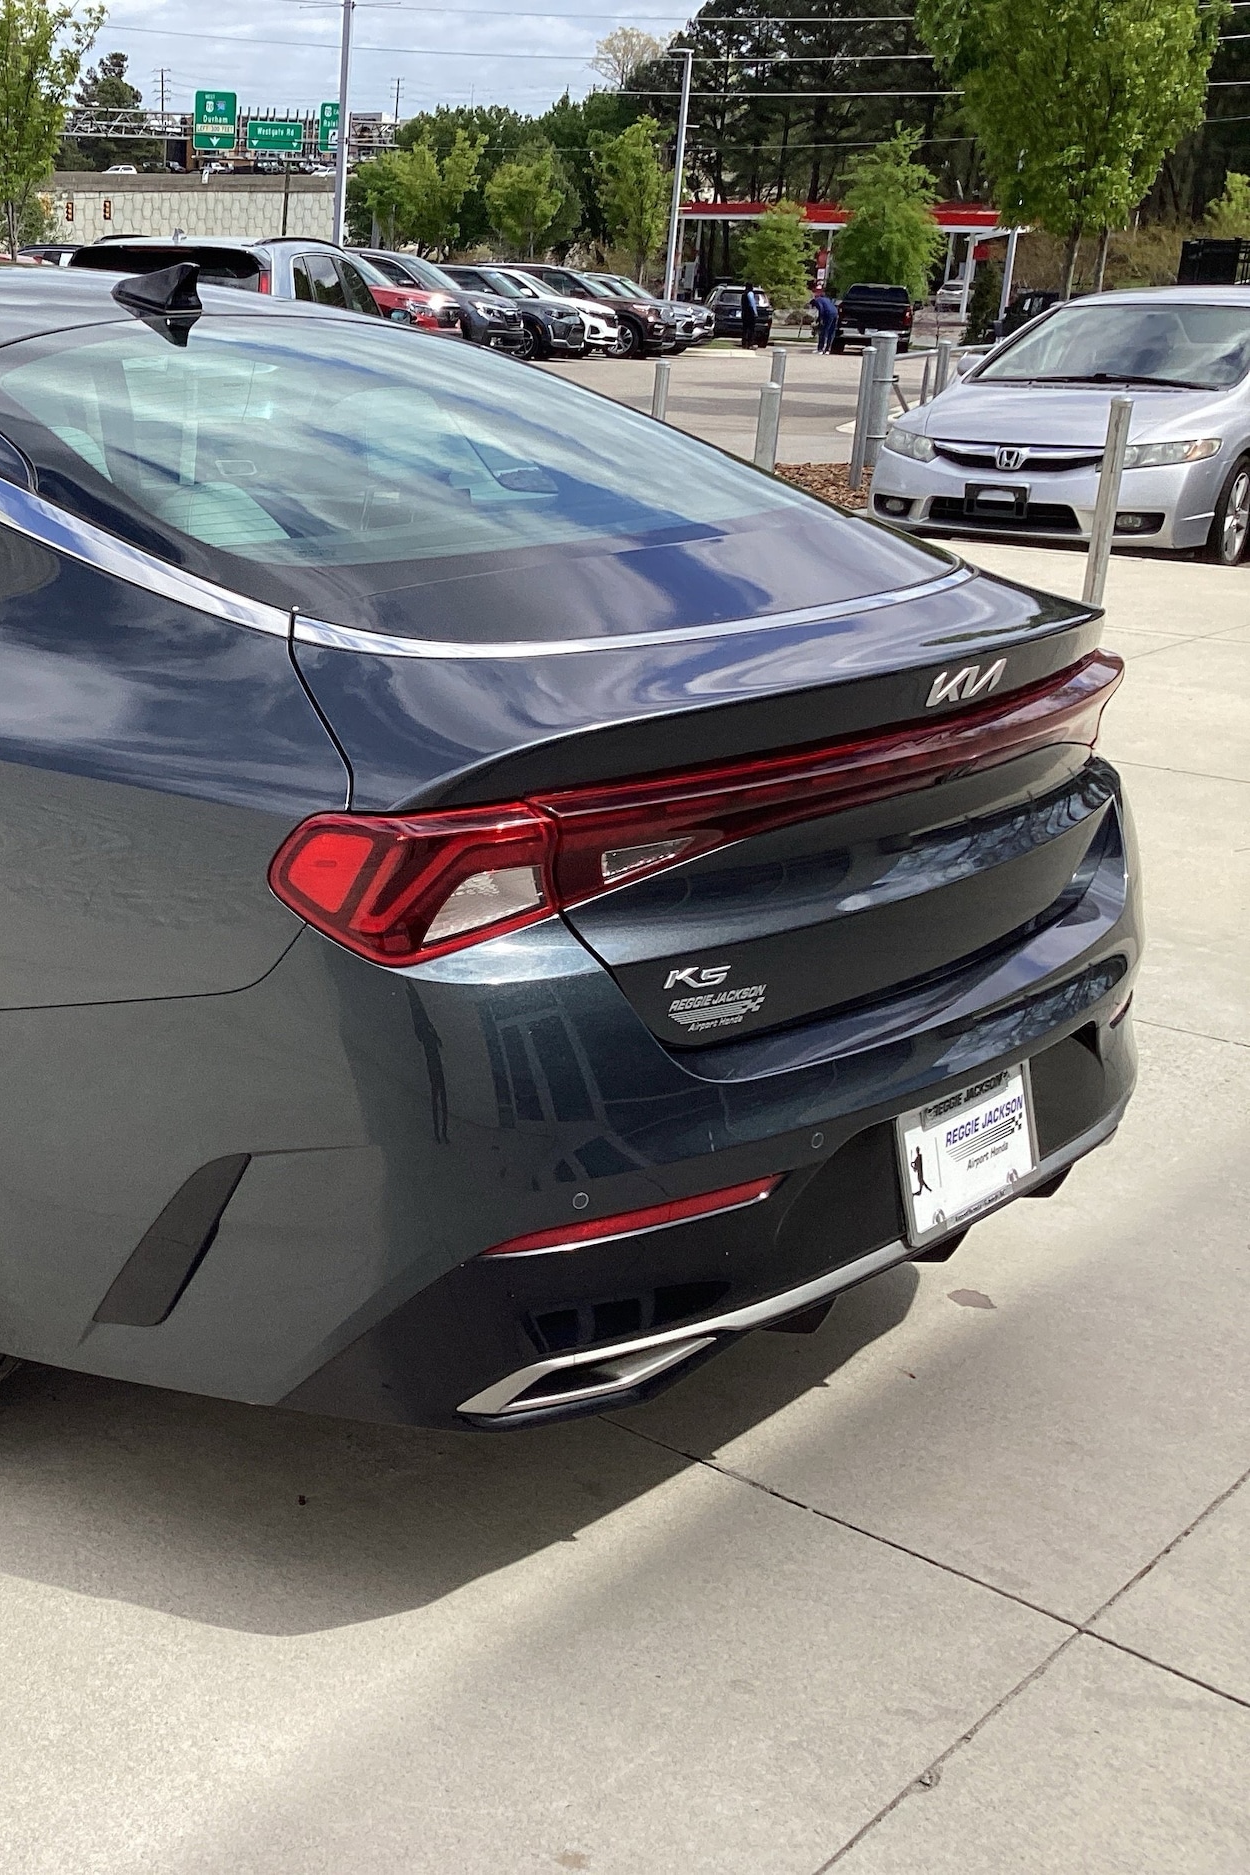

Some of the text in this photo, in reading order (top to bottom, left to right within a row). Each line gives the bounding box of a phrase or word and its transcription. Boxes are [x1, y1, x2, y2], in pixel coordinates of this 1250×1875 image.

[203, 115, 228, 123] Durham
[257, 127, 294, 137] Westgate Rd
[925, 658, 1007, 708] KIA
[663, 965, 732, 989] K5
[669, 984, 767, 1013] REGGIE JACKSON
[688, 1015, 744, 1032] Airport Honda
[932, 1072, 1003, 1117] REGGIE JACKSON
[946, 1095, 1023, 1148] REGGIE JACKSON
[967, 1141, 1008, 1171] Airport Honda
